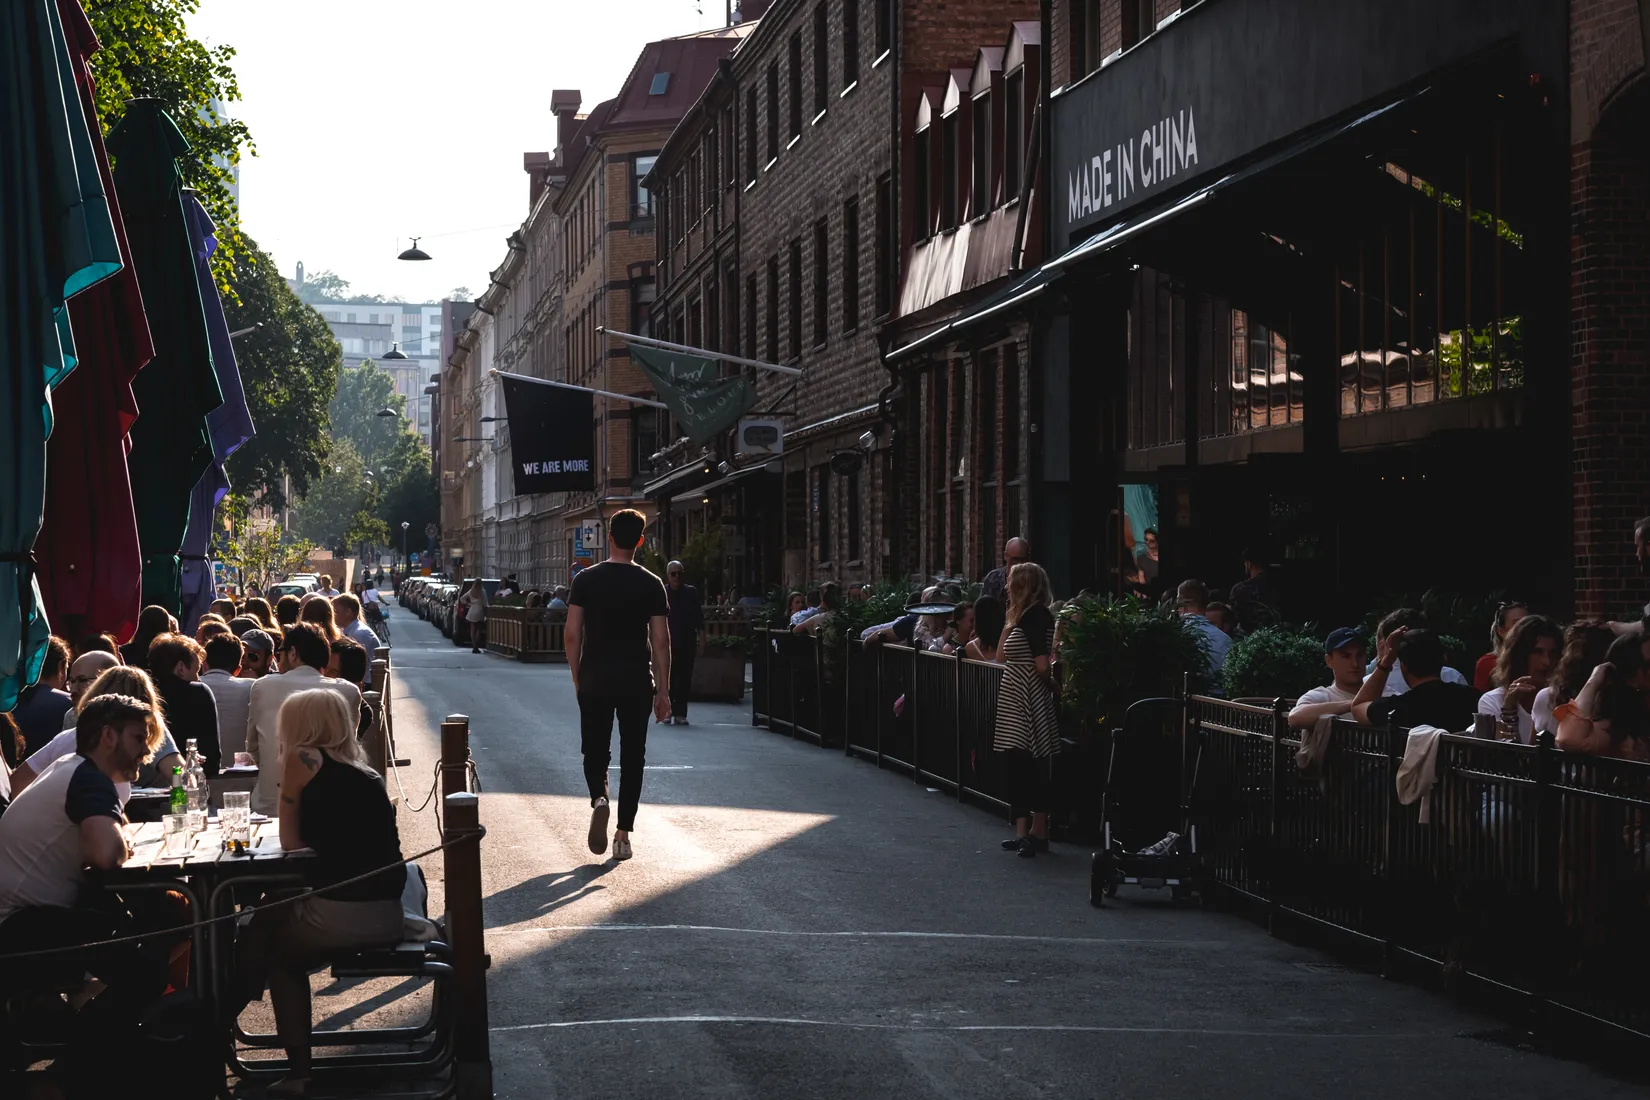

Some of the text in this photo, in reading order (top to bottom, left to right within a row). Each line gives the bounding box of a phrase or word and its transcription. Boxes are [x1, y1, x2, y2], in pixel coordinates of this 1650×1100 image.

[1068, 105, 1198, 223] MADE IN CHINA
[522, 459, 590, 475] WE ARE MORE
